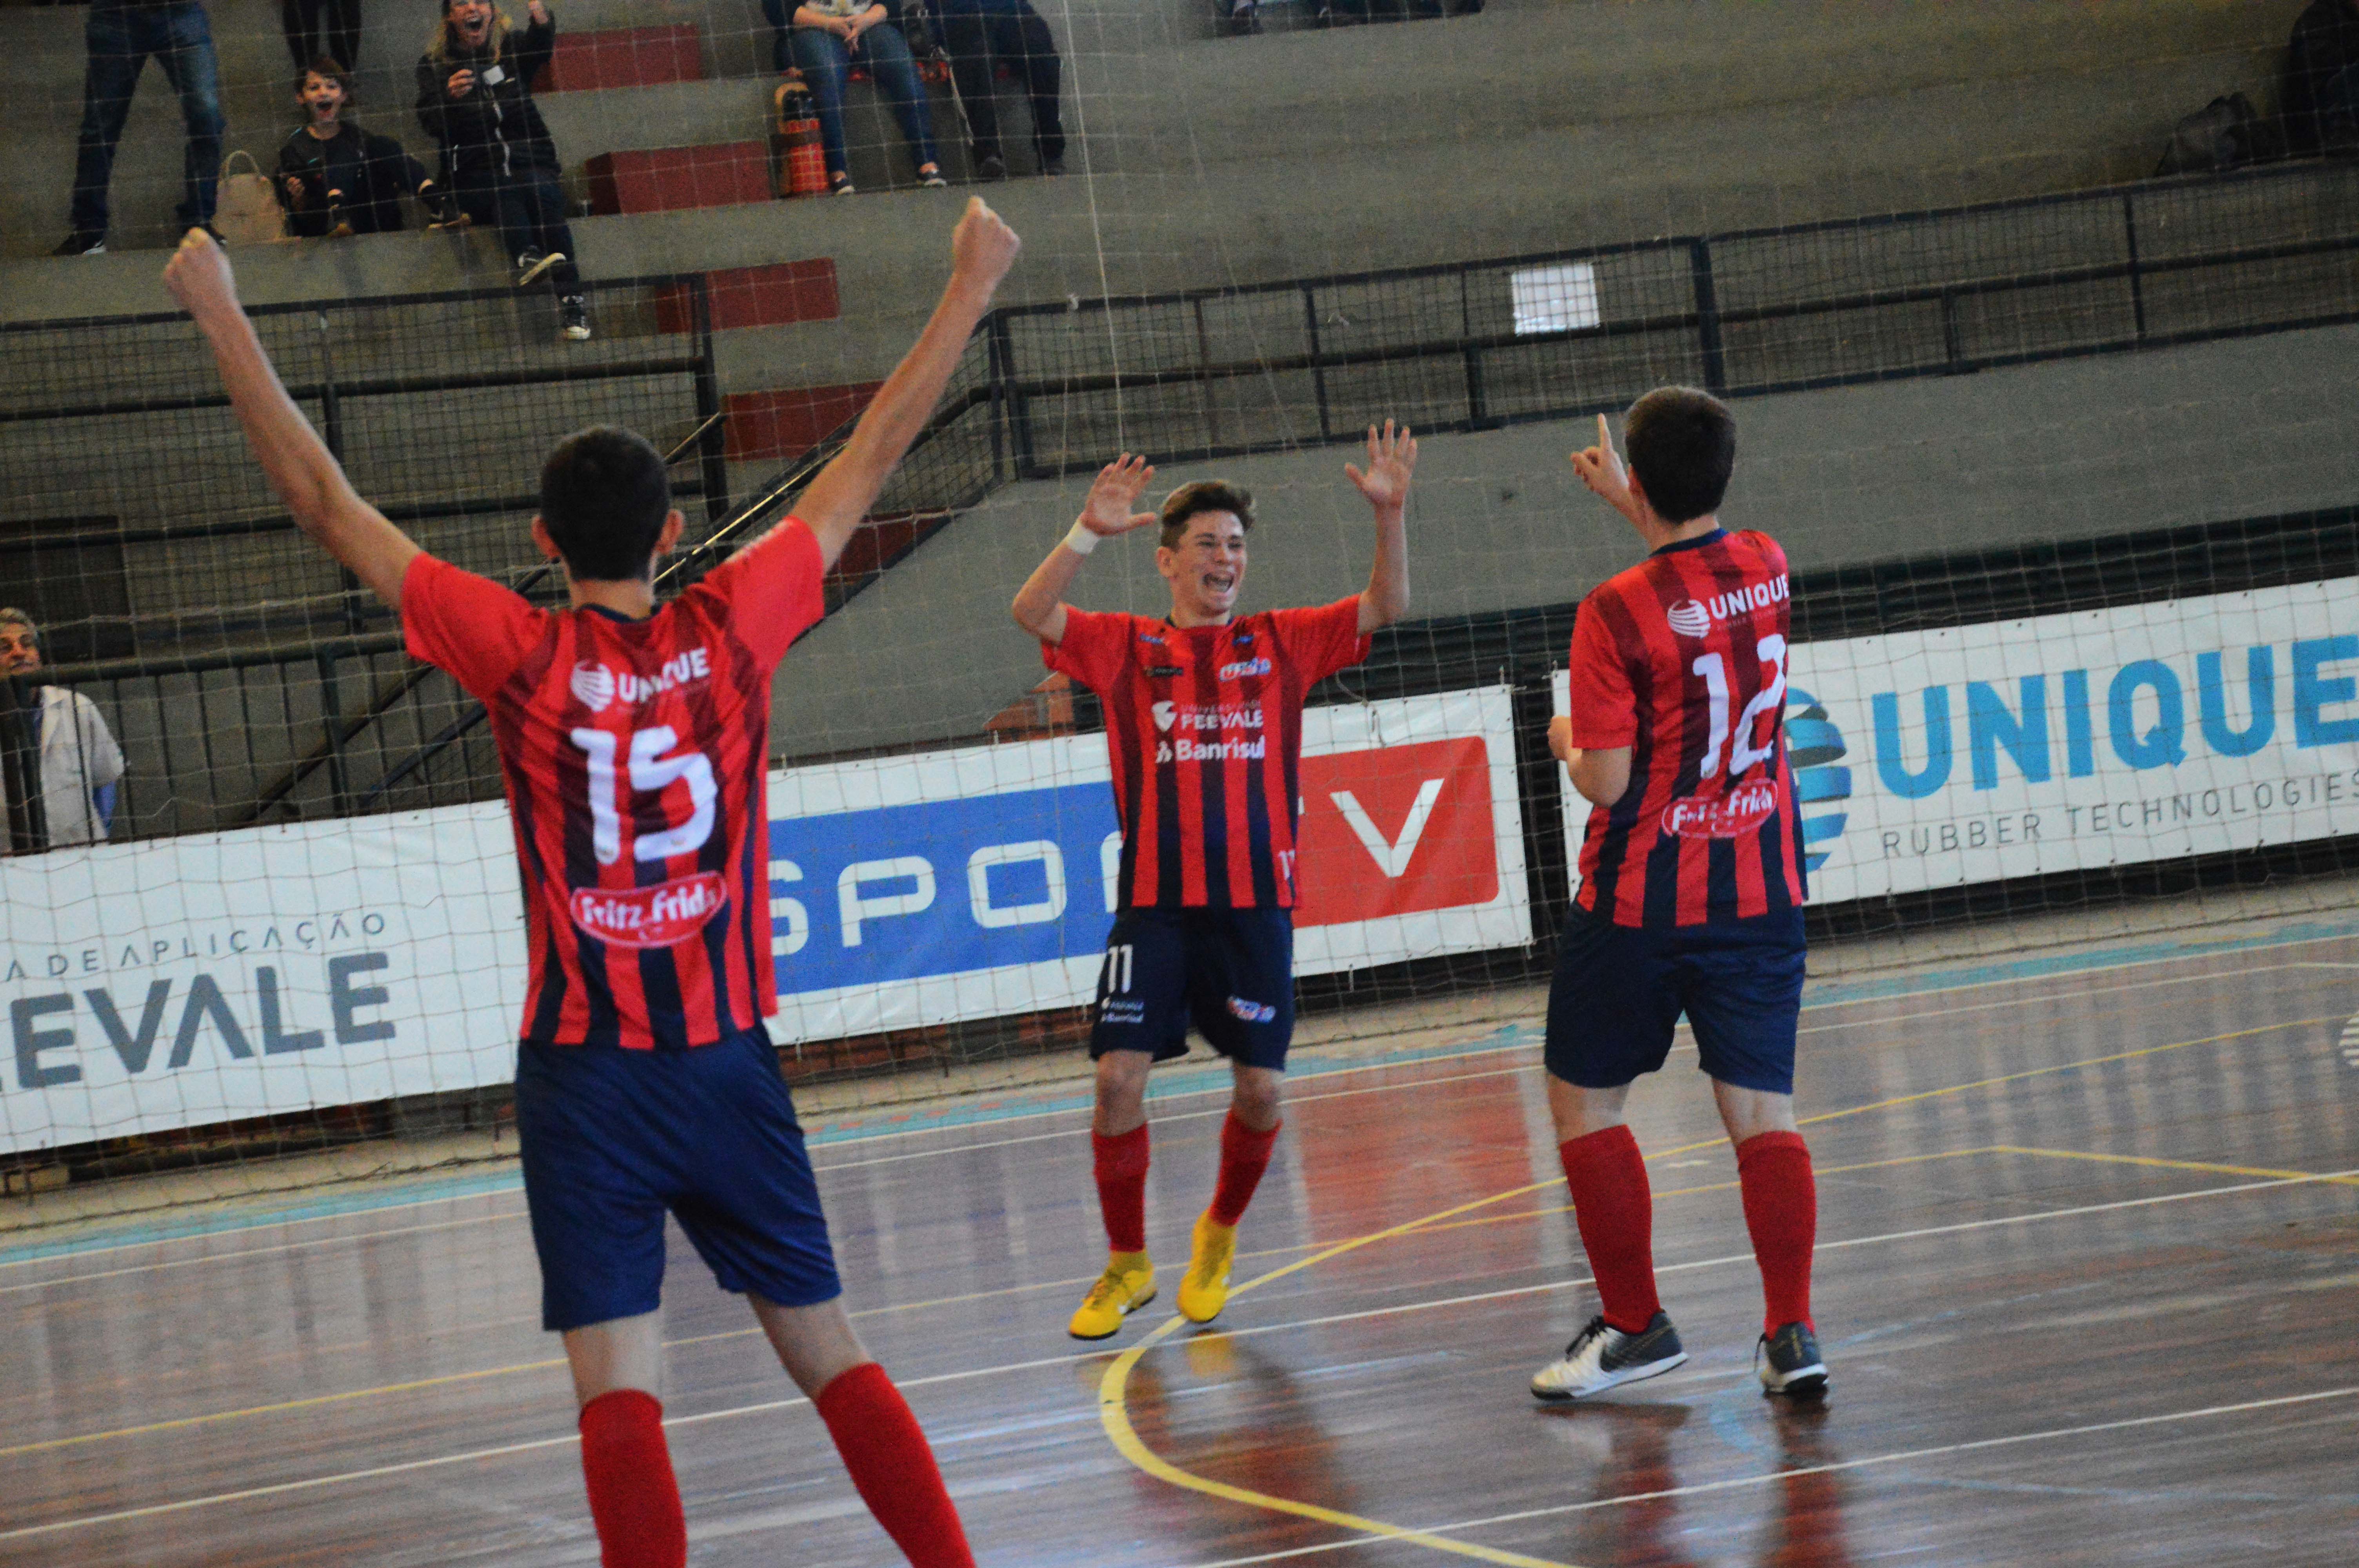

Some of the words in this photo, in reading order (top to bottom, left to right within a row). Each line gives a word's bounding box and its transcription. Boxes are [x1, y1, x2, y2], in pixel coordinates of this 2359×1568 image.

[1181, 709, 1263, 730] FEEVALE
[1693, 633, 1787, 779] 12
[1872, 634, 2359, 800] UNIQUE
[1176, 734, 1265, 761] Banrisul
[570, 724, 718, 865] 15
[1882, 814, 2041, 859] RUBBER
[47, 949, 99, 976] DE
[120, 912, 386, 967] APLICAÇÃO
[1107, 944, 1133, 993] 11
[0, 952, 395, 1089] EVALE
